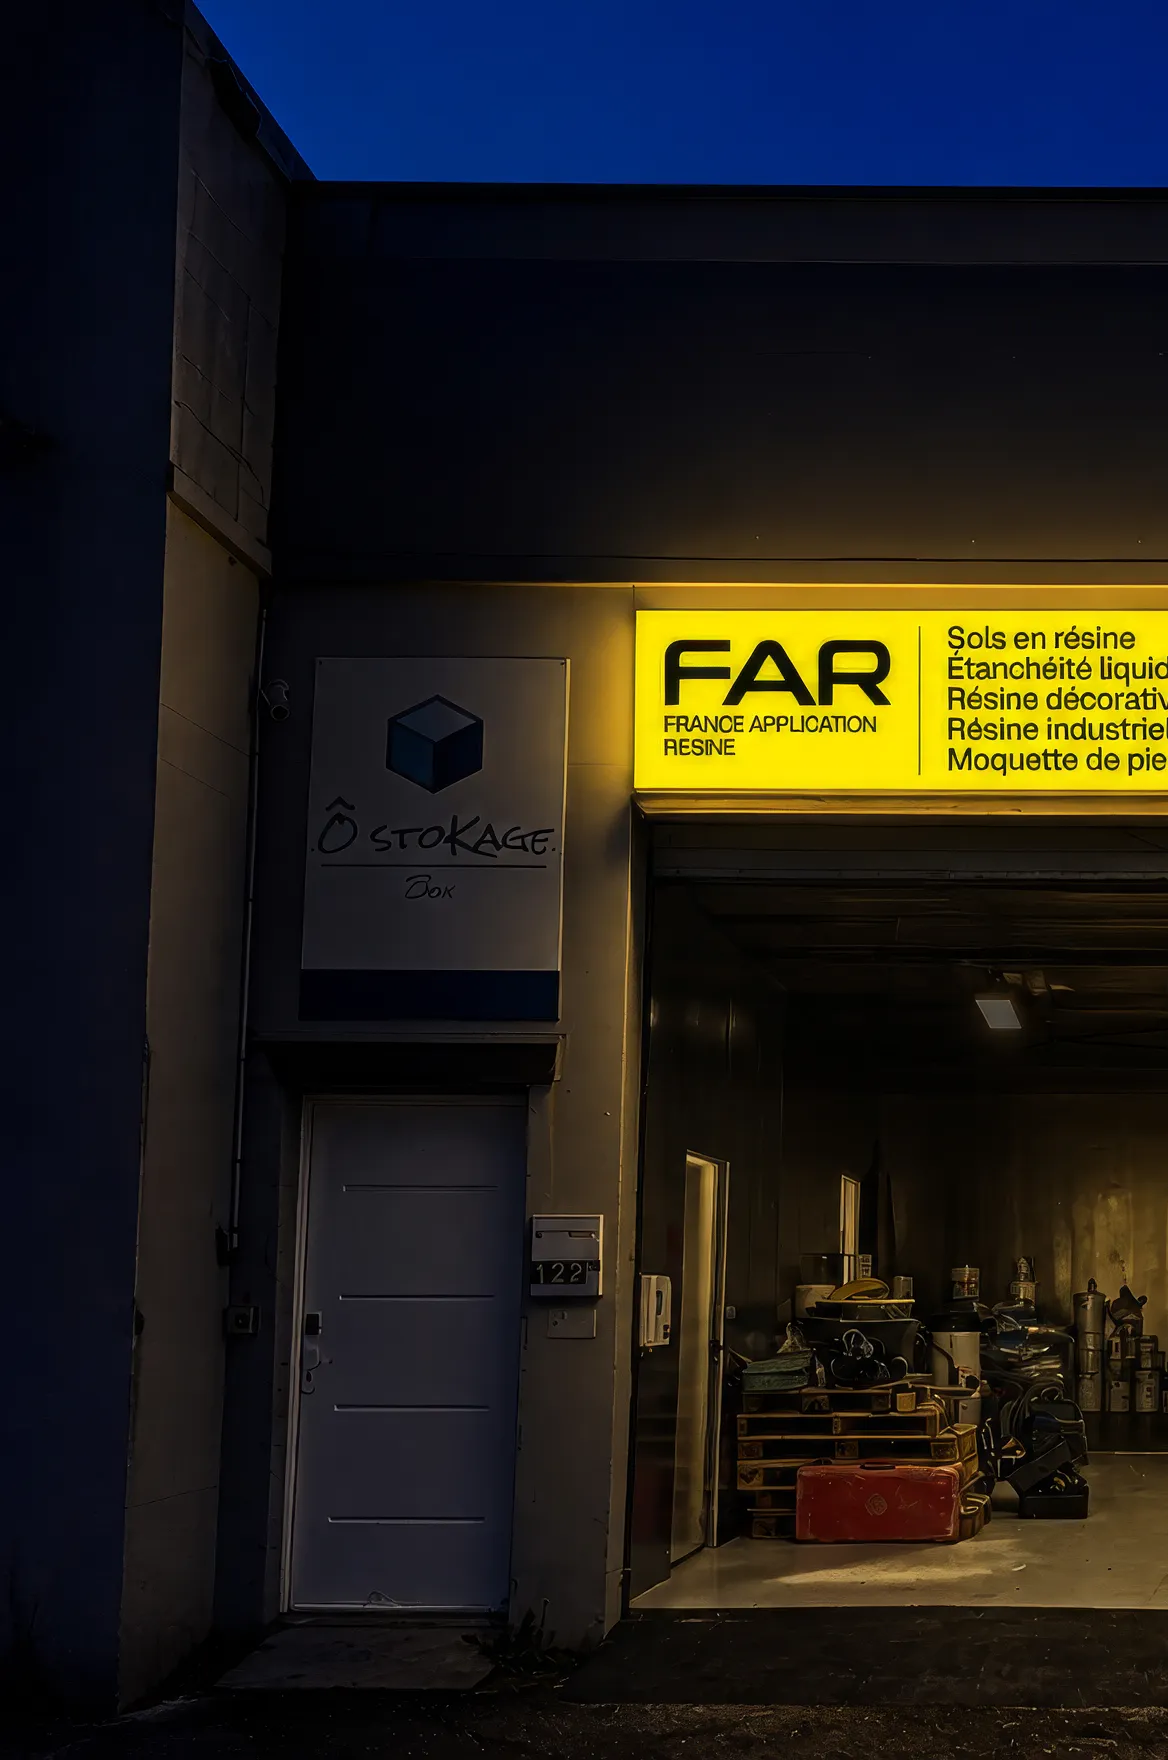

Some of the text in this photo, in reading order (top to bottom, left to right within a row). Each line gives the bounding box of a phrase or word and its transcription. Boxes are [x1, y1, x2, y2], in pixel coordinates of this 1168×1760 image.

[948, 625, 1135, 649] Sols en résine
[665, 640, 891, 706] FAR
[948, 650, 1092, 680] Étanchéité
[948, 686, 1038, 710] Résine
[664, 715, 876, 733] FRANCE APPLICATION
[948, 717, 1038, 740] Résine
[664, 739, 735, 756] RESINE
[949, 748, 1078, 776] Moquette
[1086, 747, 1120, 771] de
[536, 1262, 582, 1284] 122
